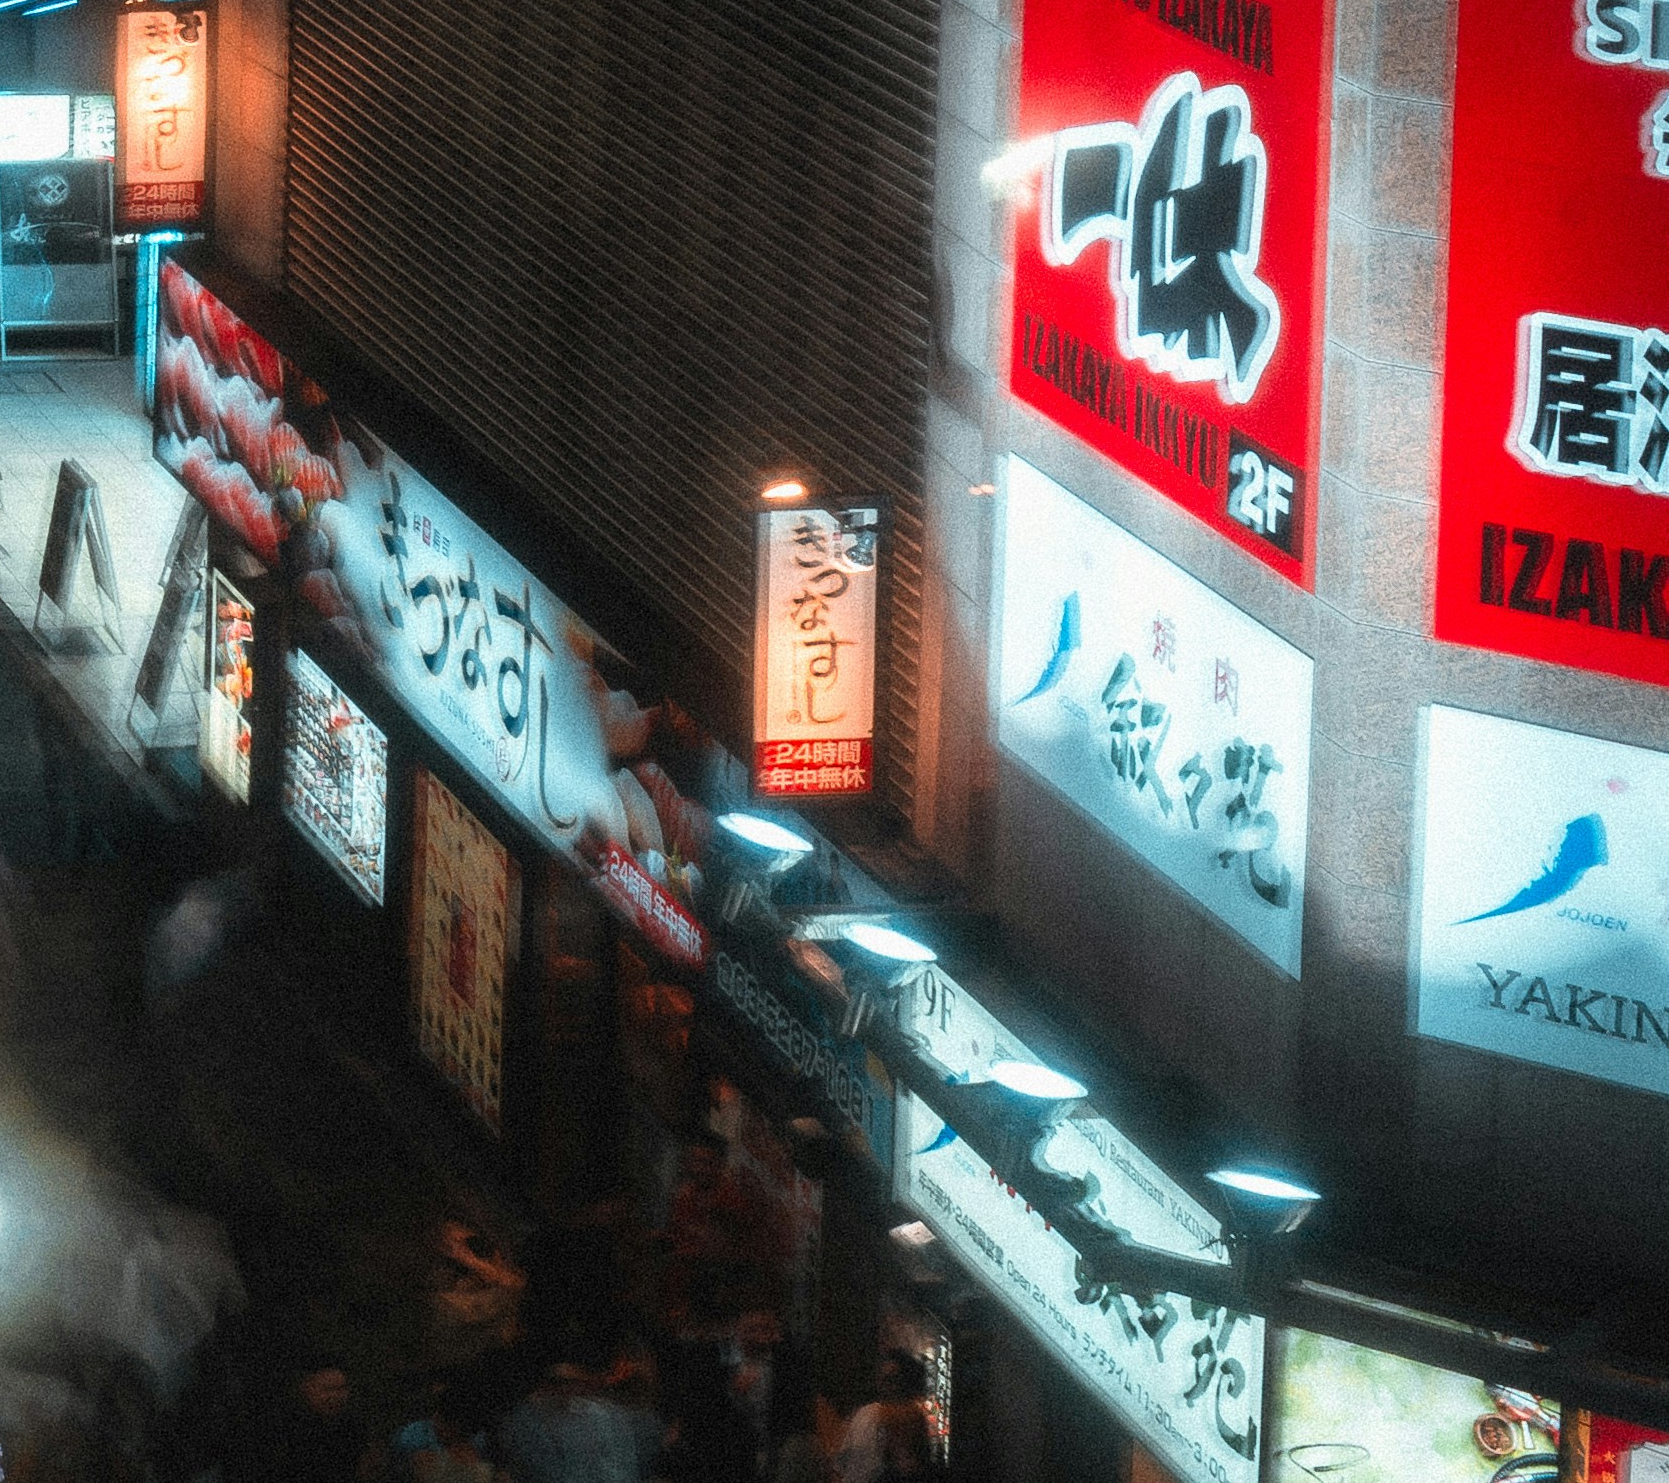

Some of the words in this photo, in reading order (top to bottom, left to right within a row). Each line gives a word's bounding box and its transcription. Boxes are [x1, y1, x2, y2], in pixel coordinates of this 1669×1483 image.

[1022, 311, 1129, 444] IZAKAYA
[1133, 382, 1220, 490] IKKYU
[1238, 448, 1295, 536] 2F
[771, 740, 862, 764] 24時間
[766, 765, 868, 791] 年中無休
[1555, 906, 1630, 933] JOJOEN
[921, 966, 957, 1037] 9F
